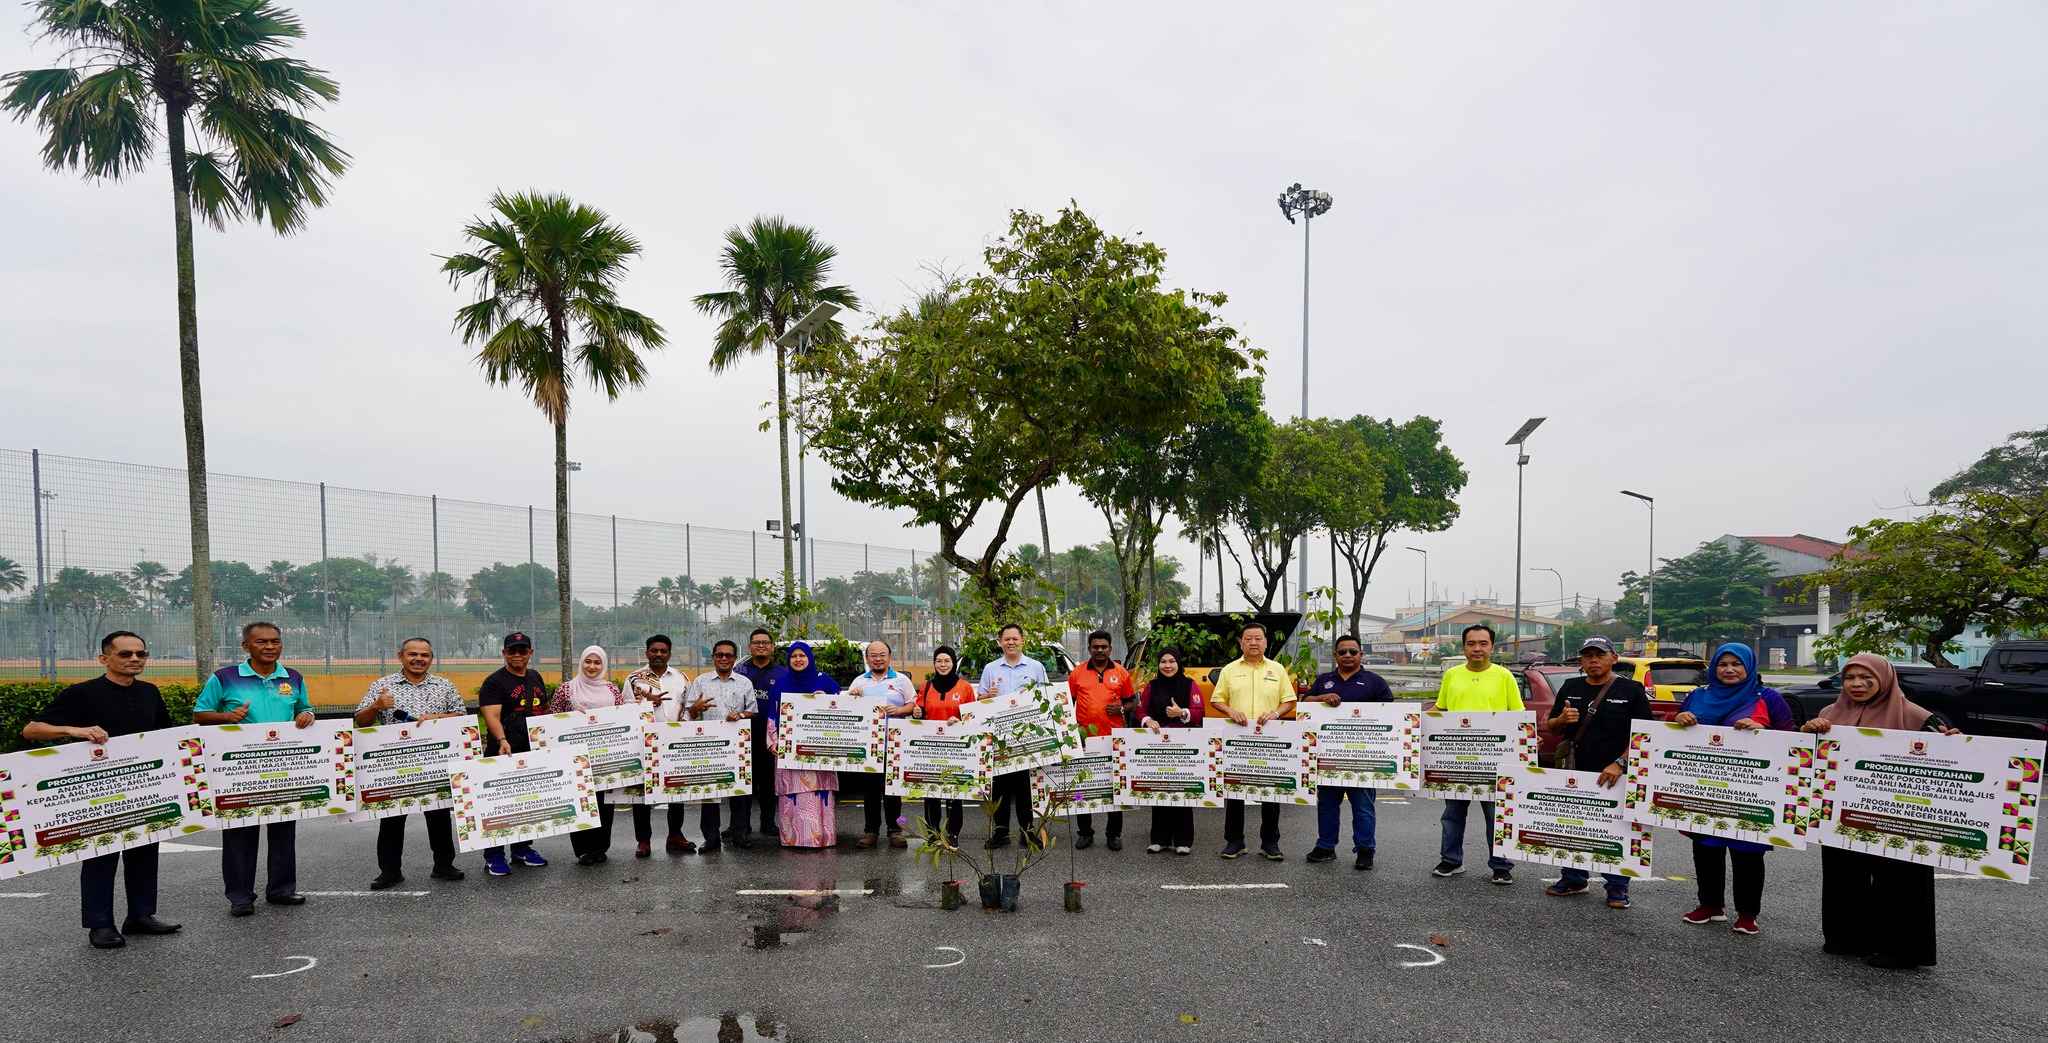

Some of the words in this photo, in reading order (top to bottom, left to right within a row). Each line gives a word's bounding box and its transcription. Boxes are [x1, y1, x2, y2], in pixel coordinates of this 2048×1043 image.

[1672, 752, 1708, 761] PROGRAM
[1710, 756, 1761, 766] PENYERAHAN
[47, 773, 95, 788] PROGRAM
[97, 762, 154, 778] PENYERAHAN
[1700, 768, 1749, 779] MAJLIS-AHLI
[1751, 774, 1779, 782] MAJLIS
[1864, 763, 1907, 773] PROGRAM
[1909, 767, 1972, 780] PENYERAHAN
[26, 793, 66, 806] KEPADA
[68, 789, 88, 798] AHLI
[90, 777, 146, 794] MAJLIS-AHLI
[148, 771, 176, 782] MAJLIS
[57, 784, 83, 793] ANAK
[86, 777, 117, 788] POKOK
[118, 771, 149, 782] HUTAN
[1670, 782, 1706, 790] PROGRAM
[1707, 786, 1757, 798] PENANAMAN
[1843, 775, 1876, 784] KEPADA
[1898, 782, 1957, 795] MAJLIS-AHLI
[1960, 789, 1995, 800] MAJLIS
[1896, 775, 1927, 784] POKOK
[1929, 779, 1963, 788] HUTAN
[55, 804, 101, 819] PROGRAM
[103, 792, 159, 809] PENANAMAN
[1566, 797, 1610, 806] PENYERAHAN
[1679, 788, 1704, 796] POKOK
[1707, 792, 1732, 800] NEGERI
[1734, 796, 1776, 806] SELANGOR
[42, 818, 67, 828] JUTA
[69, 810, 102, 823] POKOK
[104, 803, 134, 815] NEGERI
[135, 794, 179, 808] SELANGOR
[1559, 808, 1600, 817] MAJLIS-AHLI
[1848, 802, 1869, 810] JUTA
[1871, 805, 1902, 815] POKOK
[1904, 810, 1935, 820] NEGERI
[1937, 815, 1990, 828] SELANGOR
[1861, 797, 1903, 808] PROGRAM
[1905, 803, 1966, 818] PENANAMAN
[1565, 824, 1608, 834] PENANAMAN
[1588, 832, 1624, 841] SELANGOR
